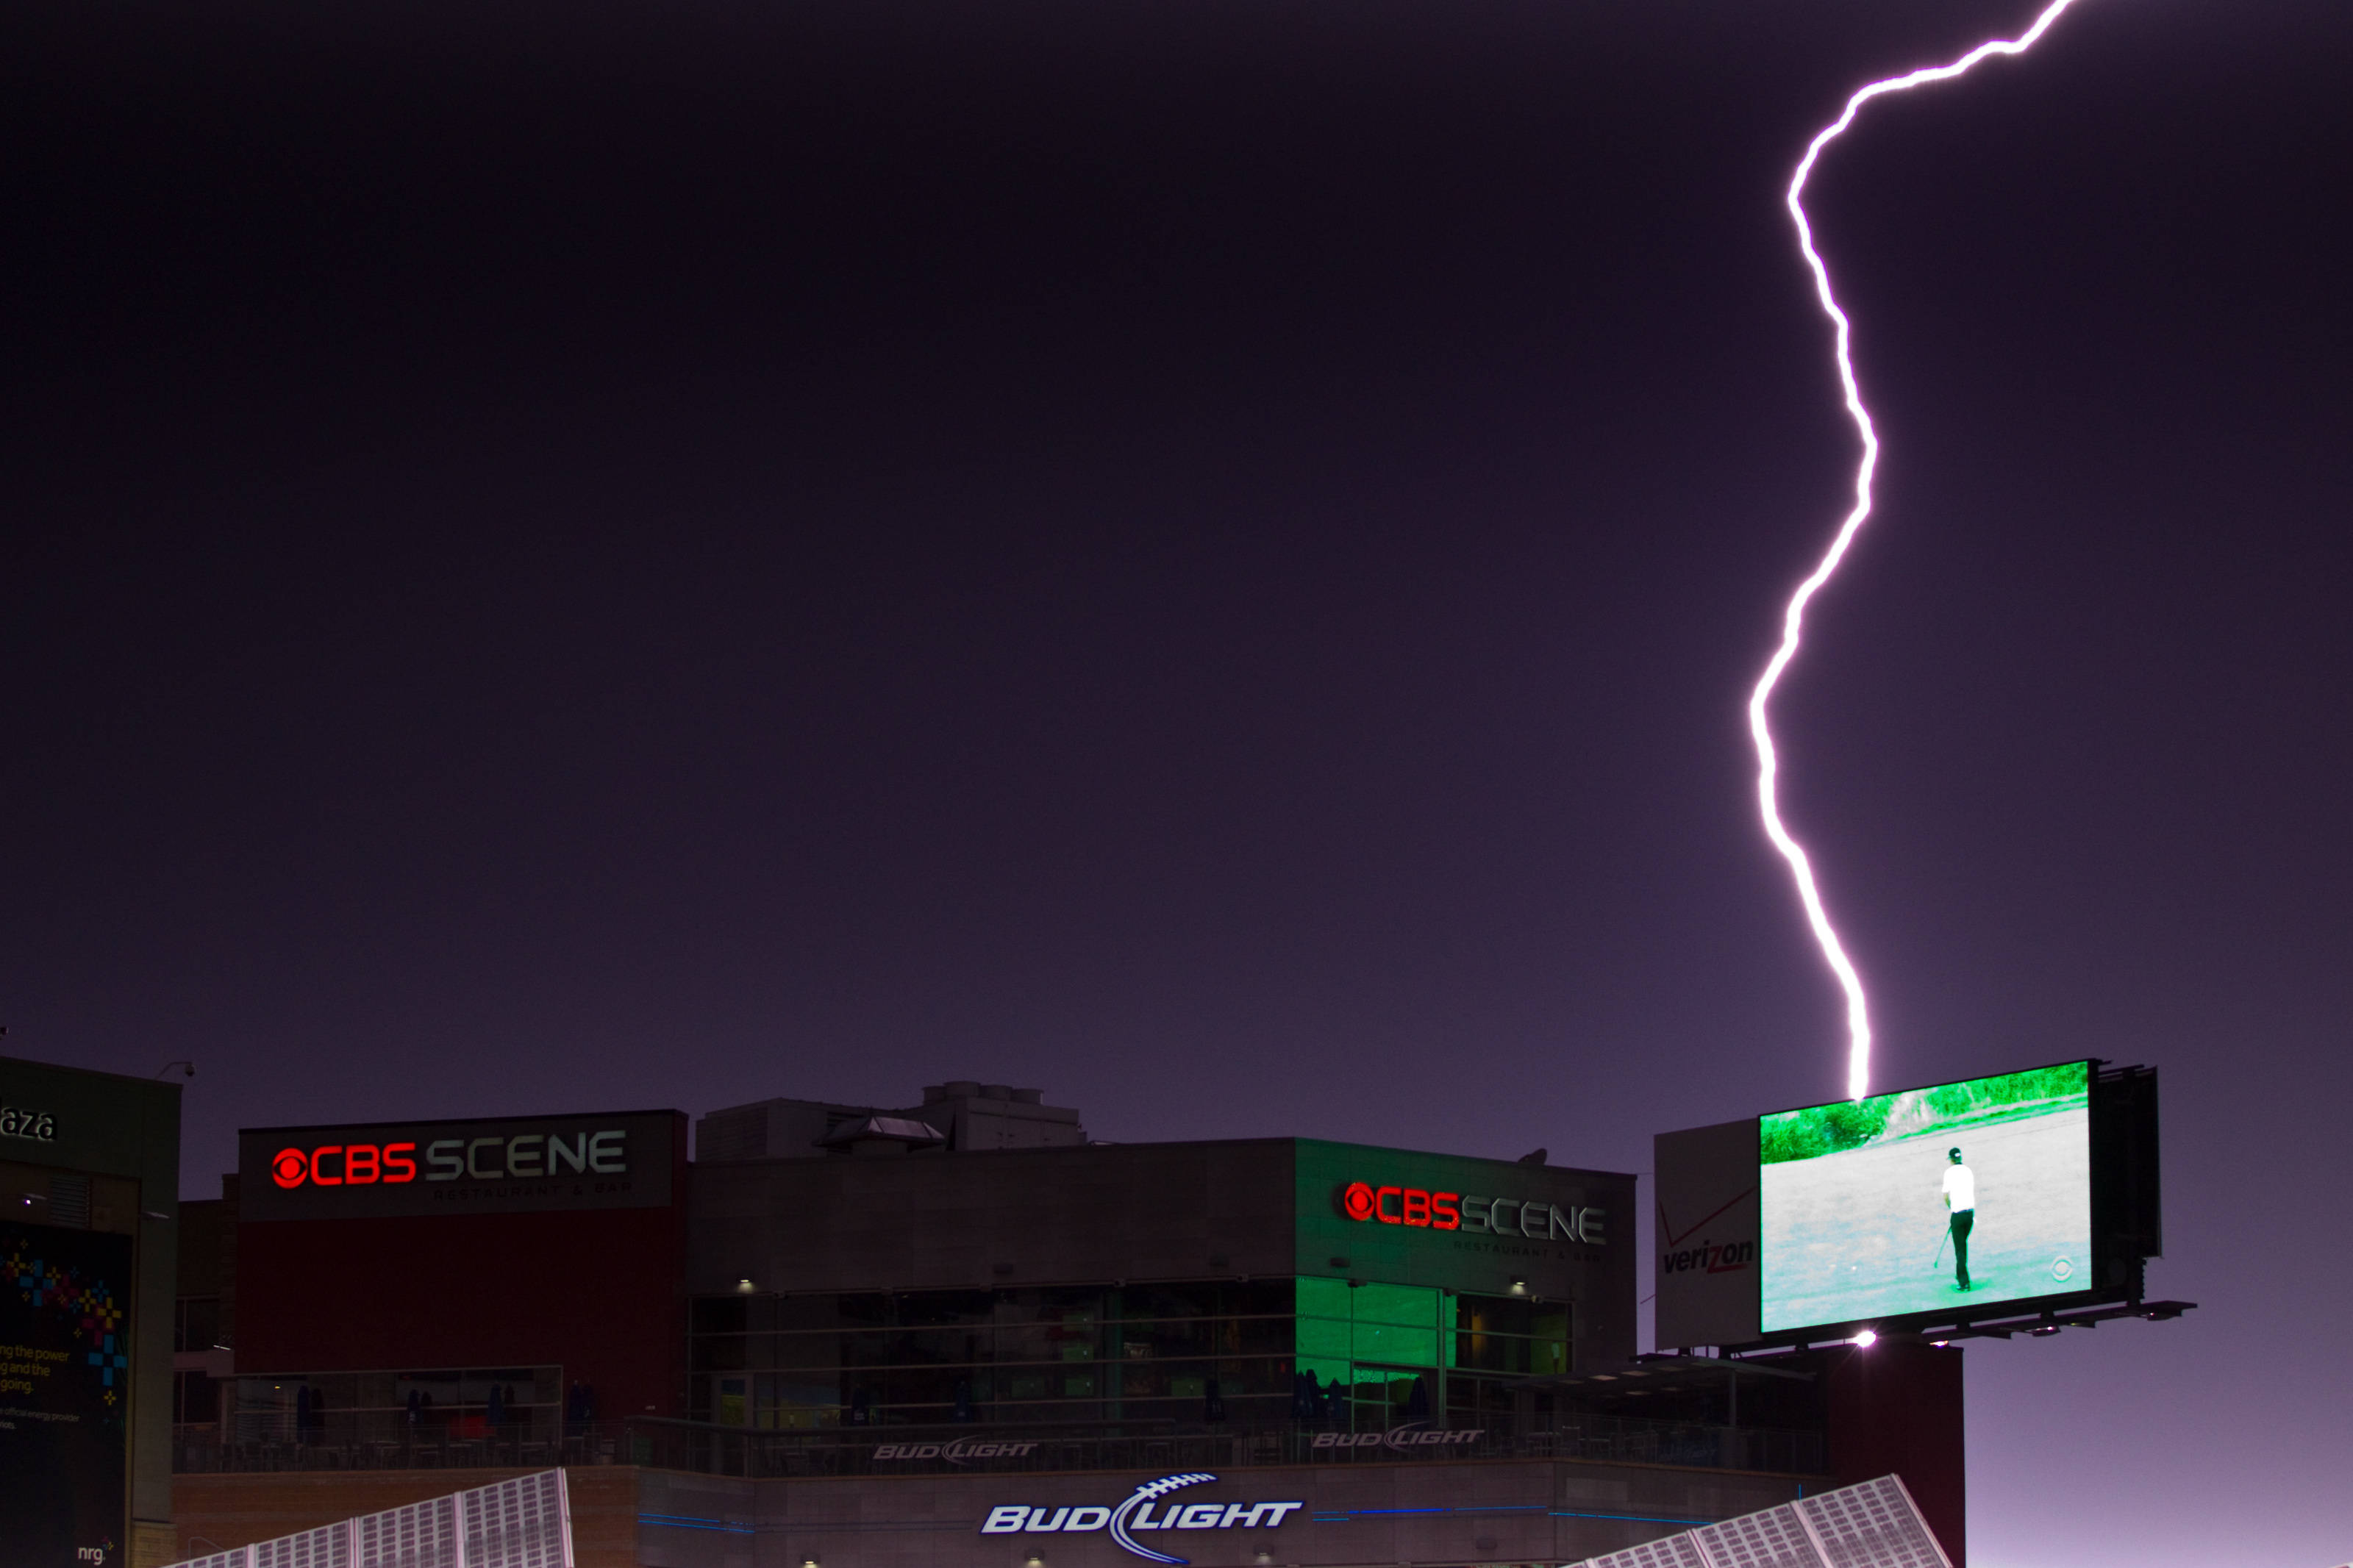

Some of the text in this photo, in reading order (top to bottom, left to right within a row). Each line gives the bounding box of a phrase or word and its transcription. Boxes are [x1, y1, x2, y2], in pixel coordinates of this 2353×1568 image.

[310, 1130, 626, 1186] CBS SCENE
[433, 1182, 632, 1200] RESTAURANT & BAR
[1375, 1186, 1607, 1245] CBS SCENE
[1453, 1240, 1548, 1259] RESTAURANT
[1573, 1252, 1601, 1263] BAR
[1664, 1239, 1754, 1273] verizon
[15, 1345, 33, 1358] the
[35, 1349, 70, 1362] power
[9, 1361, 30, 1375] and
[32, 1363, 51, 1376] the
[0, 1378, 34, 1395] going.
[28, 1411, 51, 1422] energy
[51, 1413, 80, 1422] provider
[1312, 1430, 1485, 1447] BUD LIGHT
[873, 1443, 1038, 1459] BUD LIGHT
[979, 1501, 1304, 1534] BUD LIGHT
